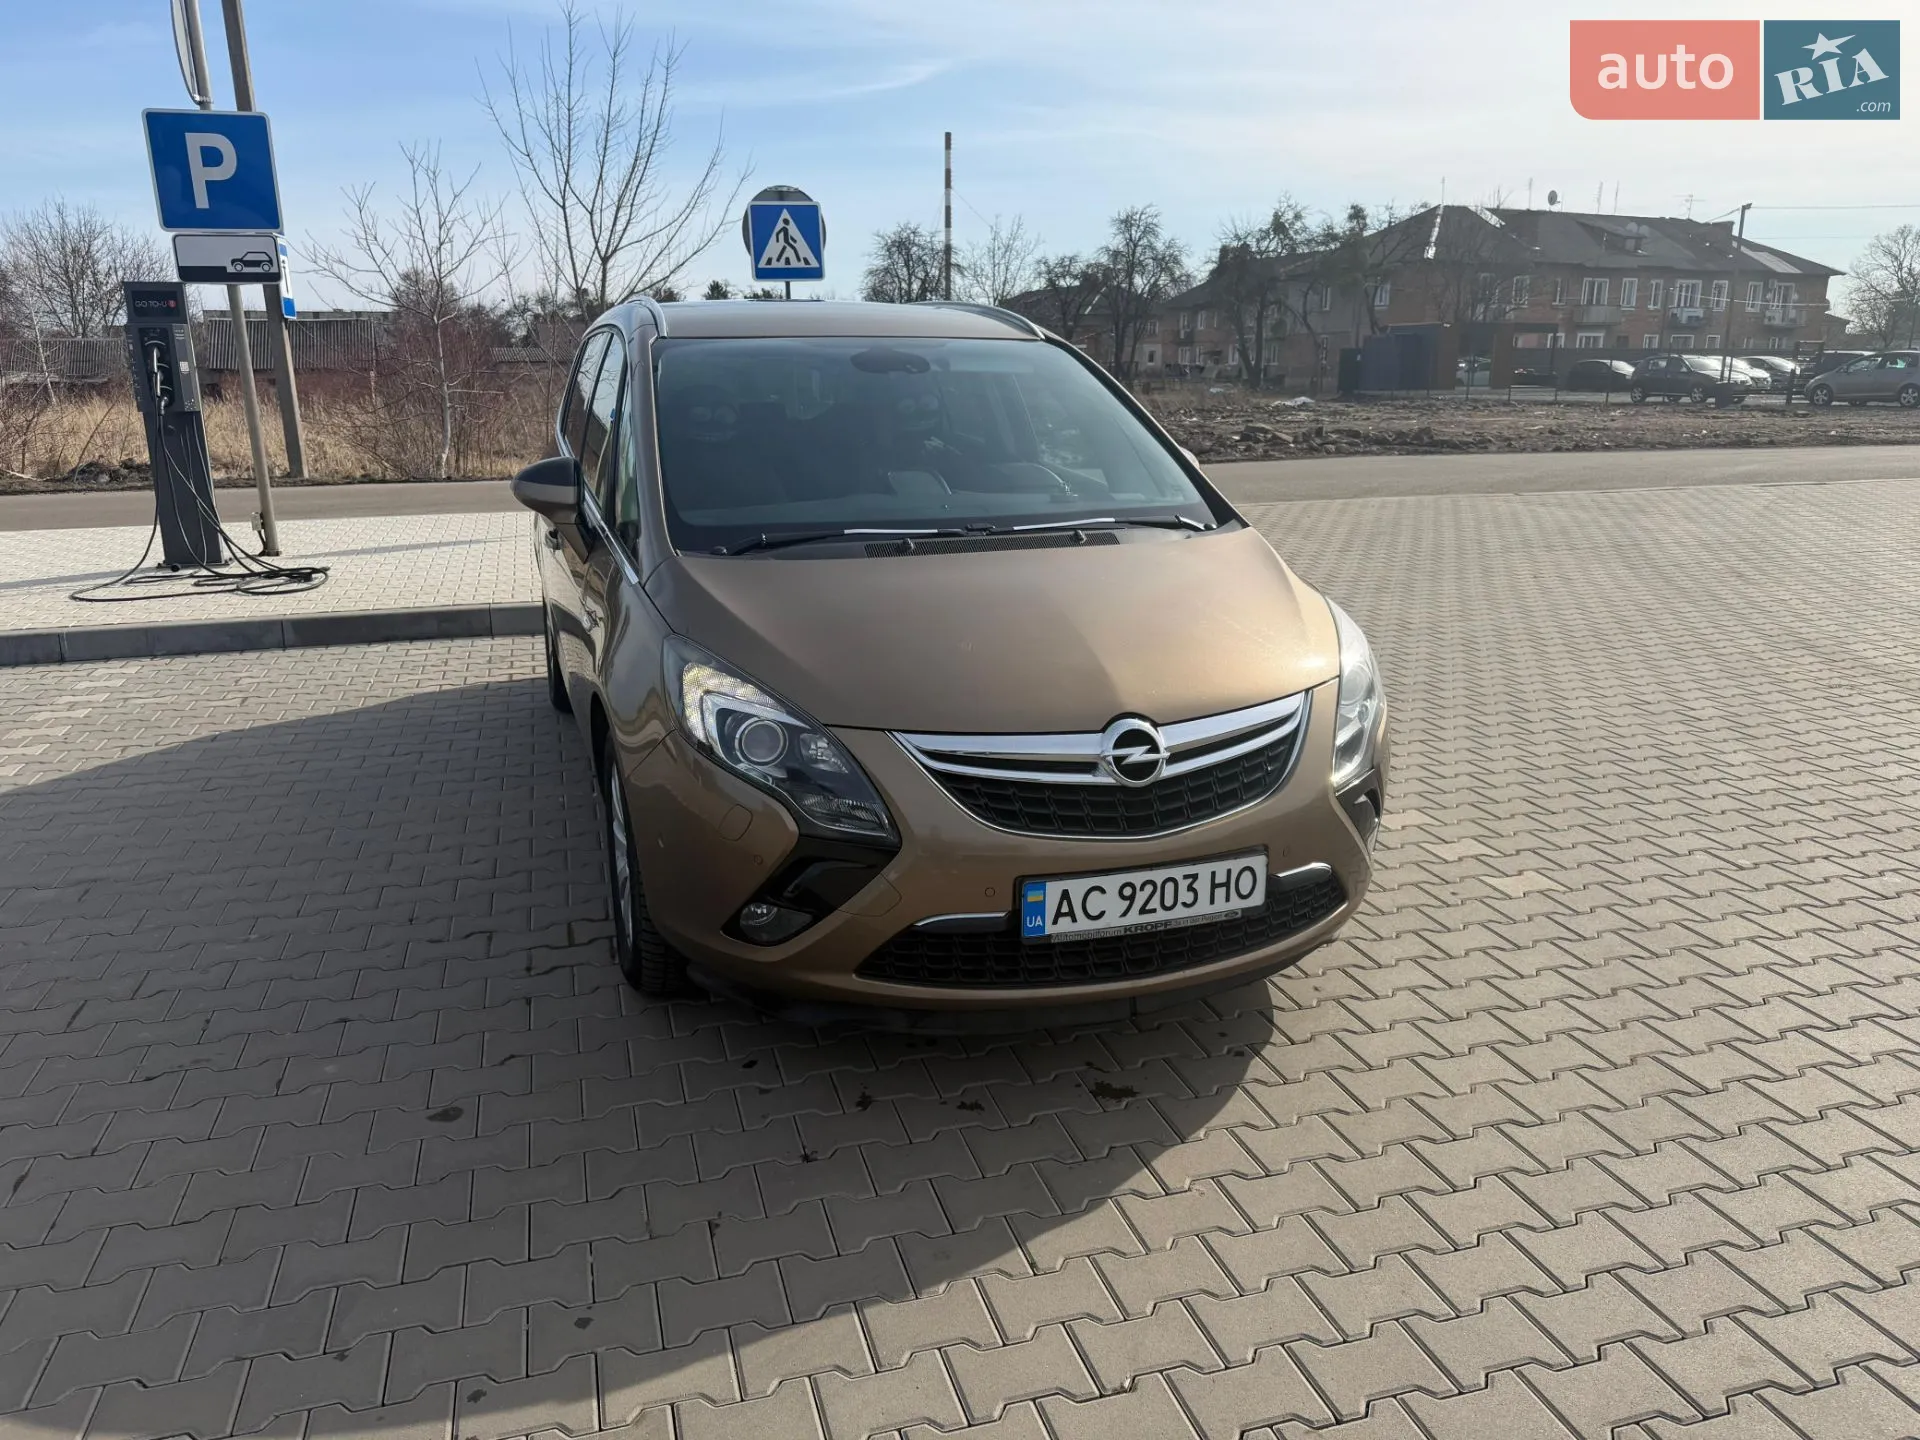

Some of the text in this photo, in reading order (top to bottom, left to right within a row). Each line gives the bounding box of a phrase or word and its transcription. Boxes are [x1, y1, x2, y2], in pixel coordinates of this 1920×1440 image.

[185, 132, 238, 209] P
[1051, 865, 1257, 926] AC 9203 HO
[1026, 915, 1043, 928] UA
[1123, 920, 1173, 934] KROPF
